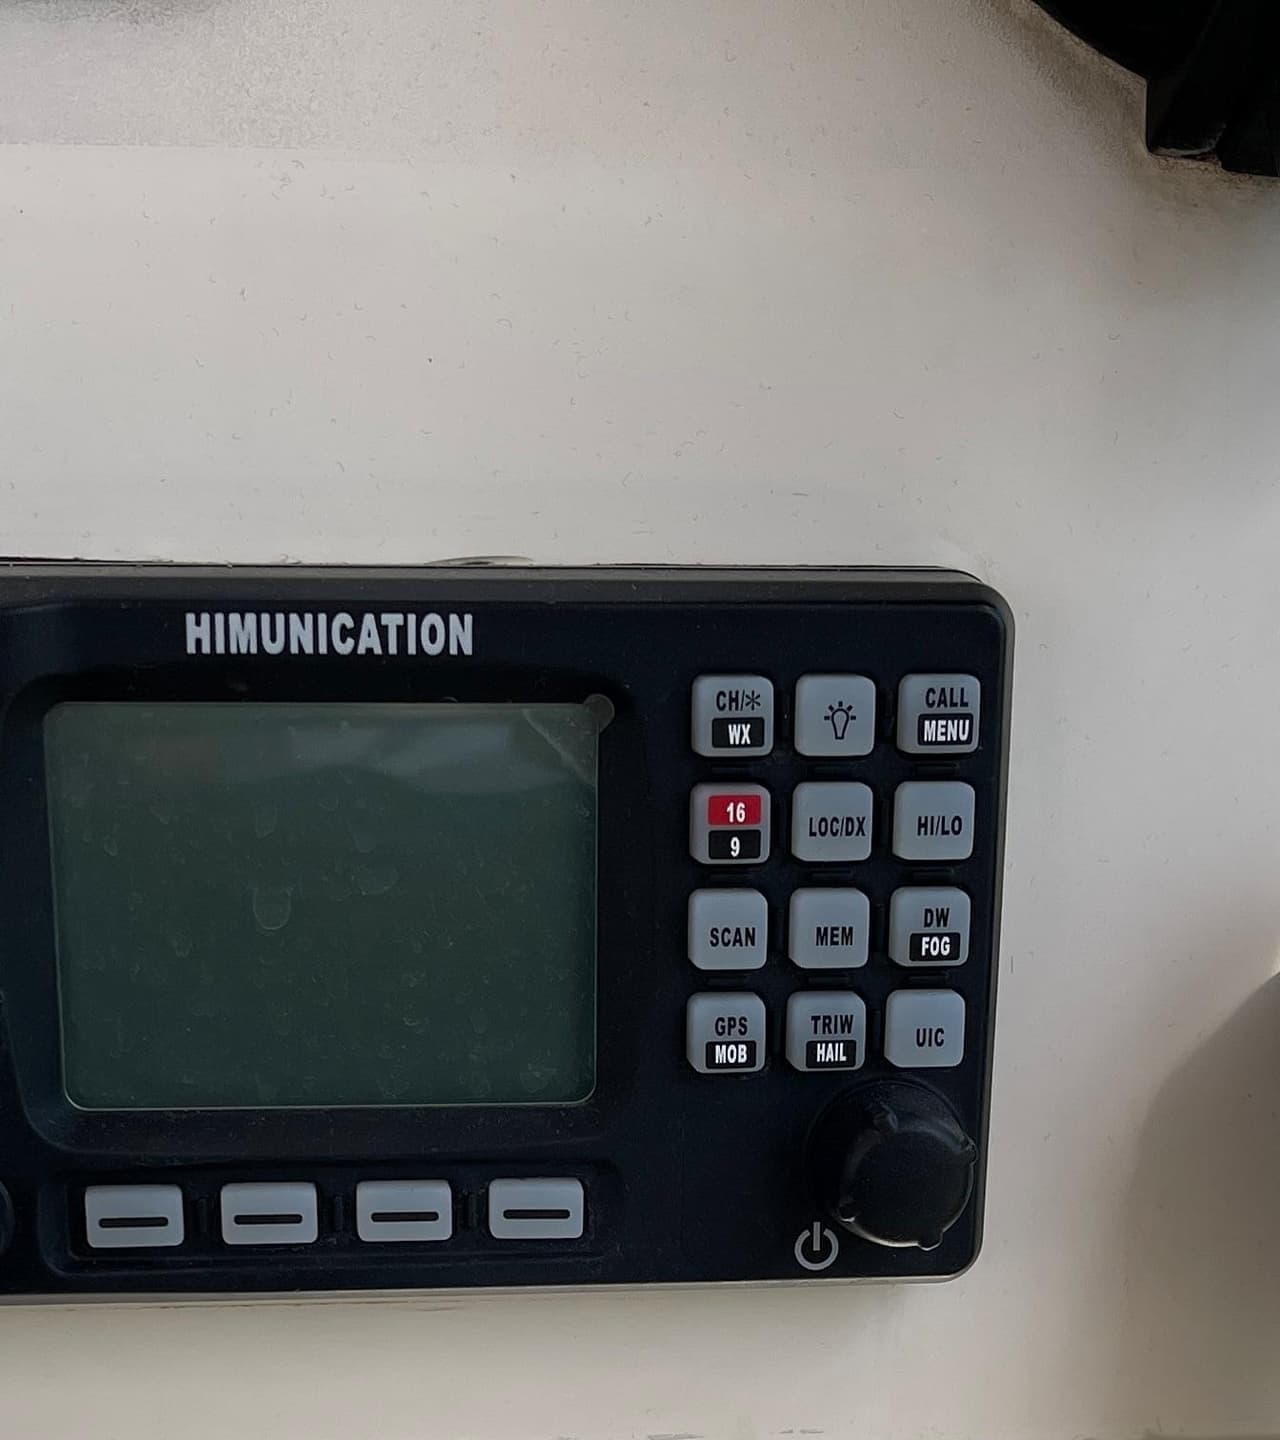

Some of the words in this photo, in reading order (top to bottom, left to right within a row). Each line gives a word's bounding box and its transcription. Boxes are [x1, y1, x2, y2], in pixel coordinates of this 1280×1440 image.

[184, 612, 476, 657] HIMUNICATION
[925, 687, 969, 709] CALL
[728, 723, 751, 746] WX
[923, 719, 970, 743] MENU
[726, 802, 746, 823] 16
[808, 816, 867, 838] LOC/DX
[917, 814, 963, 837] HI/LO
[730, 837, 741, 858] 9
[923, 907, 950, 929] DW
[709, 927, 757, 948] SCAN
[815, 927, 854, 947] MEM
[921, 936, 951, 958] FOG
[714, 1016, 749, 1037] GPS
[810, 1014, 854, 1036] TRIW
[915, 1027, 946, 1048] UIC
[714, 1043, 748, 1065] MOB
[815, 1041, 848, 1064] HAIL
